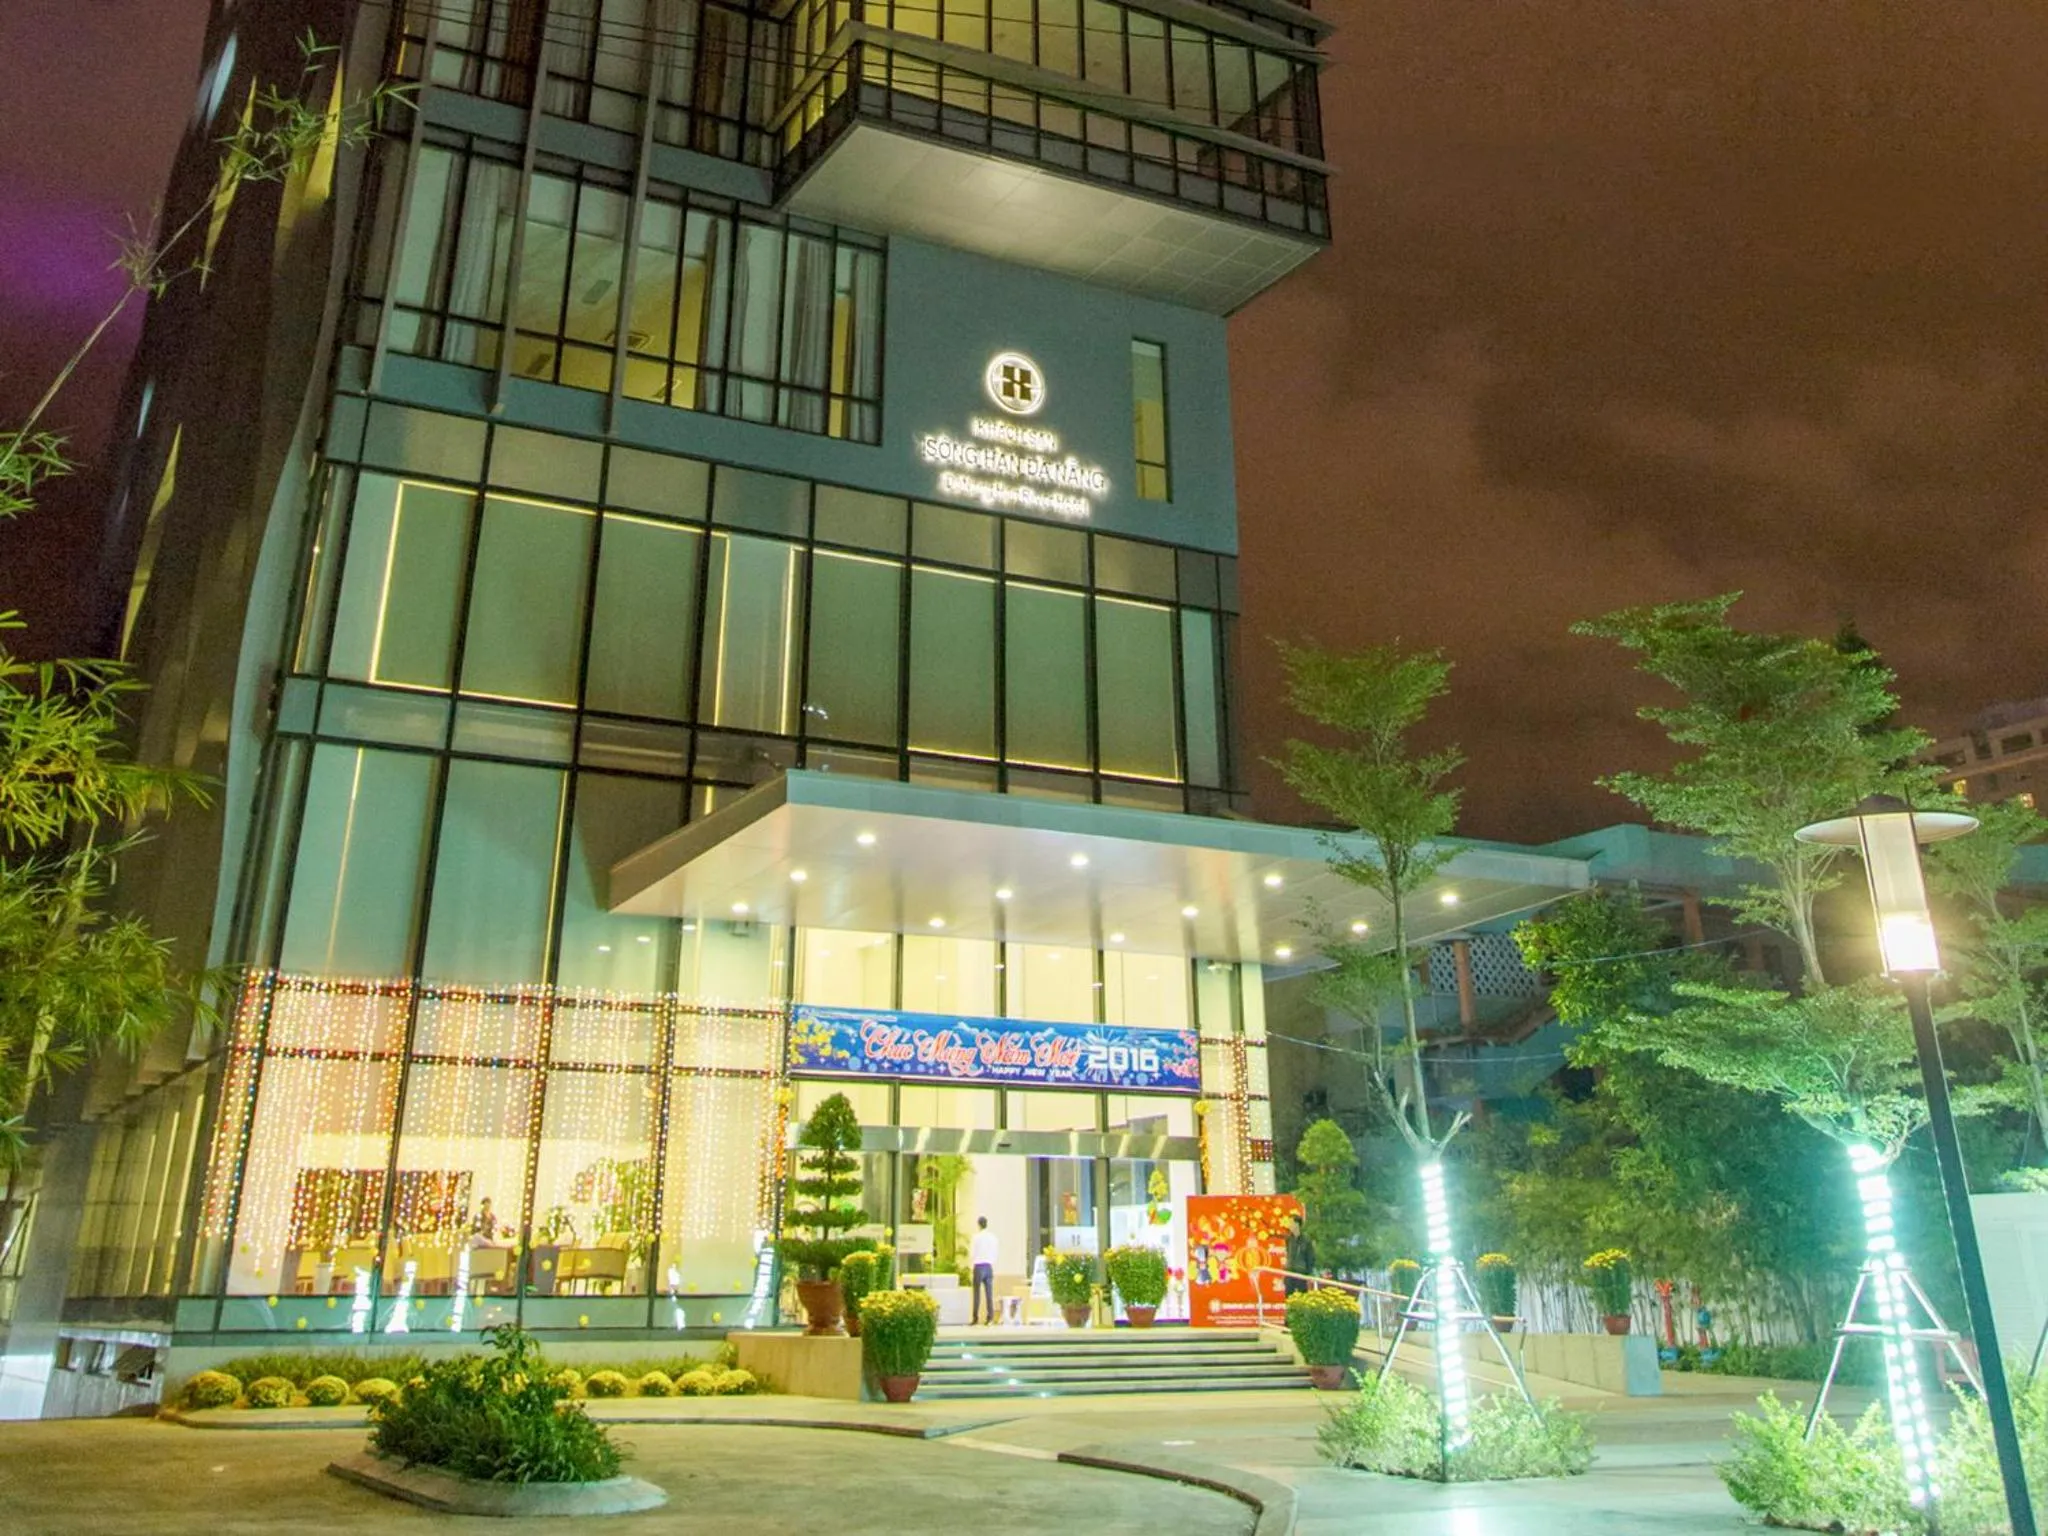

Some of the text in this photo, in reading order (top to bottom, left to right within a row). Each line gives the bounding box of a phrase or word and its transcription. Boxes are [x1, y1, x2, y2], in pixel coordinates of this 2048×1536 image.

[925, 435, 978, 465] SÔNG
[860, 1019, 915, 1059] Chúc
[991, 1065, 1073, 1079] HAPPY NEW YEAR
[1087, 1045, 1159, 1073] 2016
